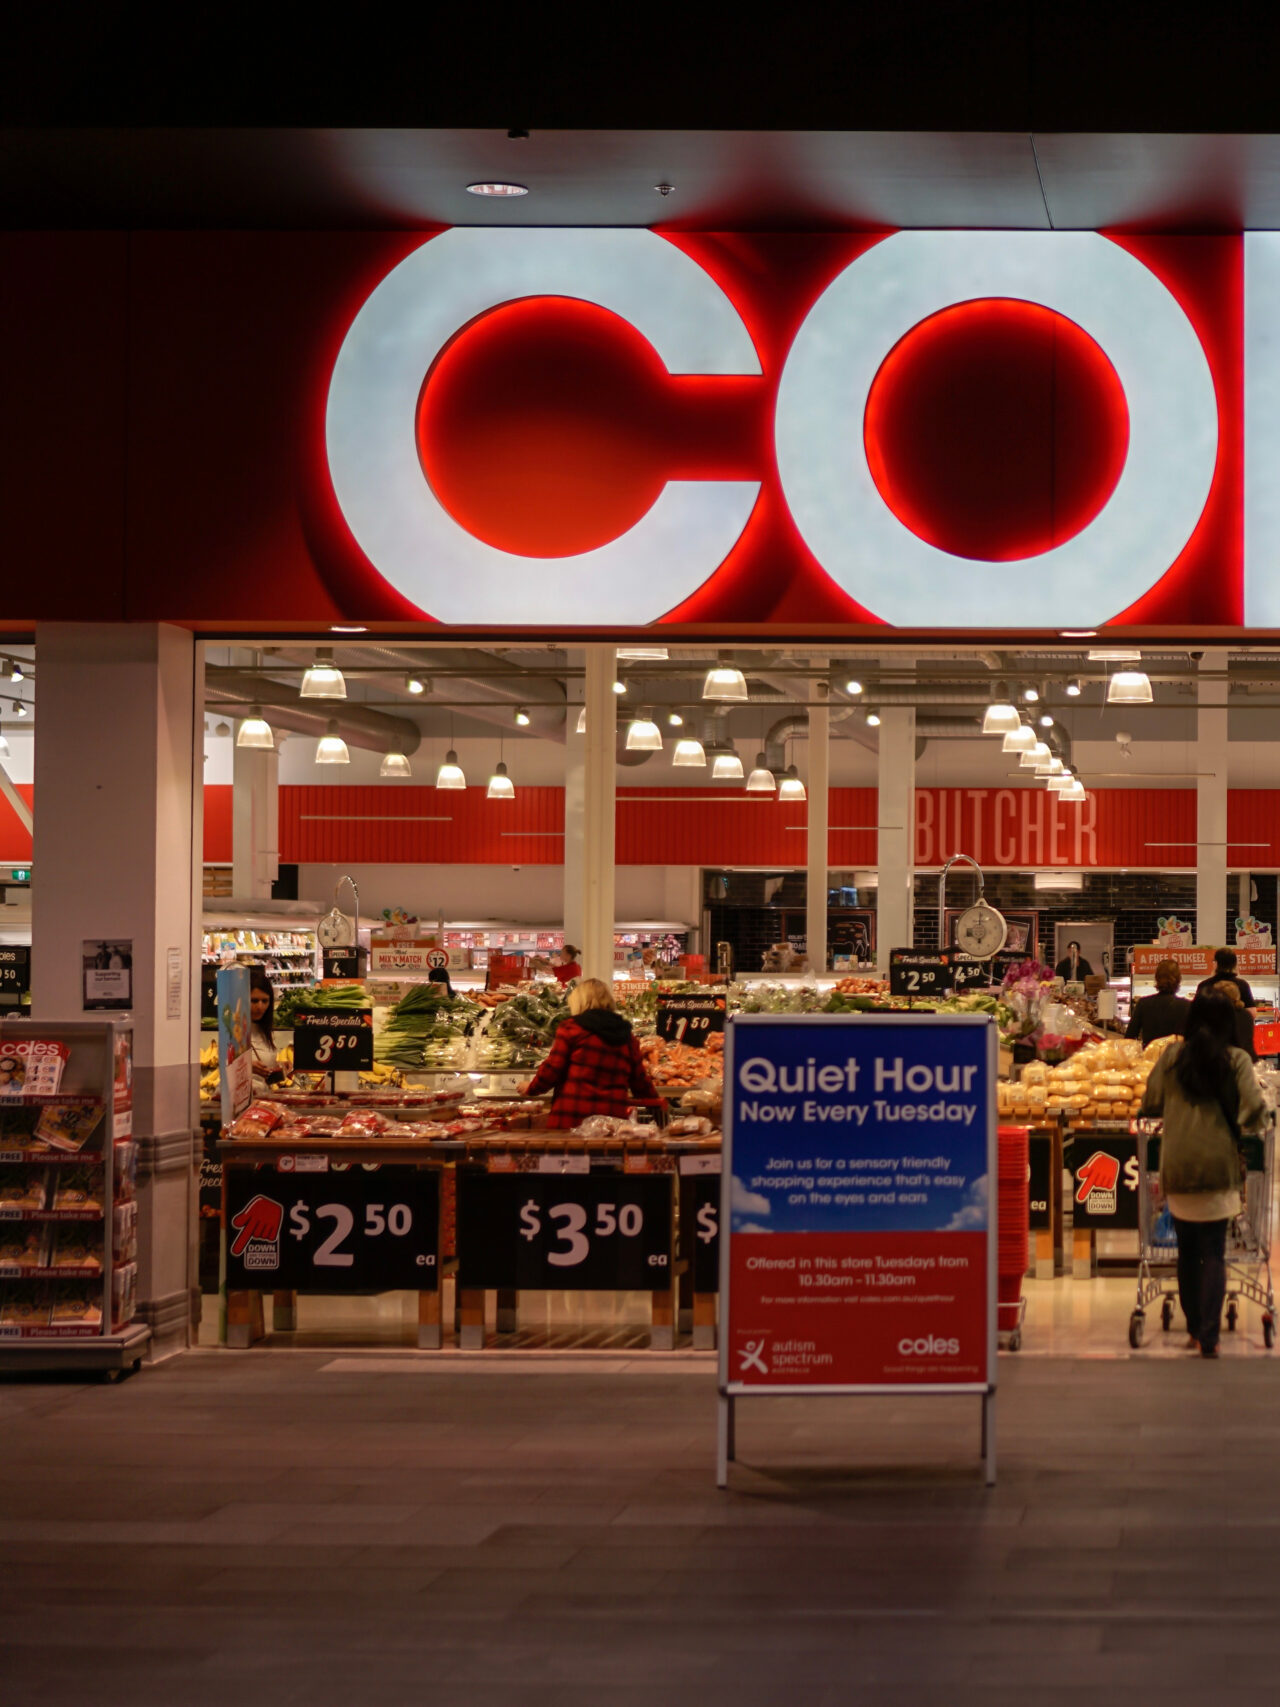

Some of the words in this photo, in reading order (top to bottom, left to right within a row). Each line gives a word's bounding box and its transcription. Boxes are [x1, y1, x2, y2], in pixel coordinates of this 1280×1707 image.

[914, 789, 1098, 865] BUTCHER
[0, 951, 16, 961] oles
[1140, 954, 1147, 964] A
[1149, 954, 1169, 964] FREE
[1171, 952, 1206, 964] STIKEEZ
[1236, 954, 1247, 964] EE
[1249, 953, 1276, 964] STIKE
[621, 982, 650, 990] STIKEEZ
[665, 999, 686, 1009] Fresh
[687, 999, 715, 1010] Specials
[305, 1015, 330, 1027] Fresh
[330, 1014, 362, 1028] Specials
[1, 1040, 60, 1056] coles
[739, 1057, 860, 1093] Quiet
[873, 1057, 978, 1092] Hour
[740, 1101, 796, 1122] Now
[803, 1100, 869, 1126] Every
[873, 1100, 977, 1126] Tuesday
[199, 1158, 224, 1174] Fres
[765, 1158, 793, 1170] Join
[797, 1160, 813, 1169] us
[815, 1157, 833, 1169] for
[836, 1160, 846, 1169] a
[849, 1159, 900, 1172] sensory
[902, 1156, 951, 1171] friendly
[751, 1175, 814, 1189] shopping
[817, 1175, 893, 1188] experience
[896, 1174, 931, 1186] that's
[934, 1176, 966, 1188] easy
[788, 1193, 806, 1203] on
[810, 1192, 831, 1203] the
[834, 1194, 866, 1206] eyes
[868, 1191, 895, 1203] and
[898, 1192, 928, 1203] ears
[1030, 1200, 1047, 1210] ea
[247, 1244, 276, 1252] DOWN
[247, 1258, 276, 1266] DOWN
[415, 1254, 436, 1266] ea
[648, 1254, 668, 1267] ea
[746, 1257, 795, 1269] Offered
[800, 1257, 811, 1269] in
[815, 1257, 838, 1269] this
[841, 1257, 873, 1269] store
[875, 1256, 935, 1270] Tuesdays
[938, 1256, 968, 1268] from
[799, 1274, 853, 1287] 10.30am
[865, 1274, 916, 1286] 11.30am
[0, 1328, 20, 1336] FREE
[772, 1339, 816, 1352] autism
[898, 1334, 960, 1355] coles
[772, 1352, 833, 1366] spectrum
